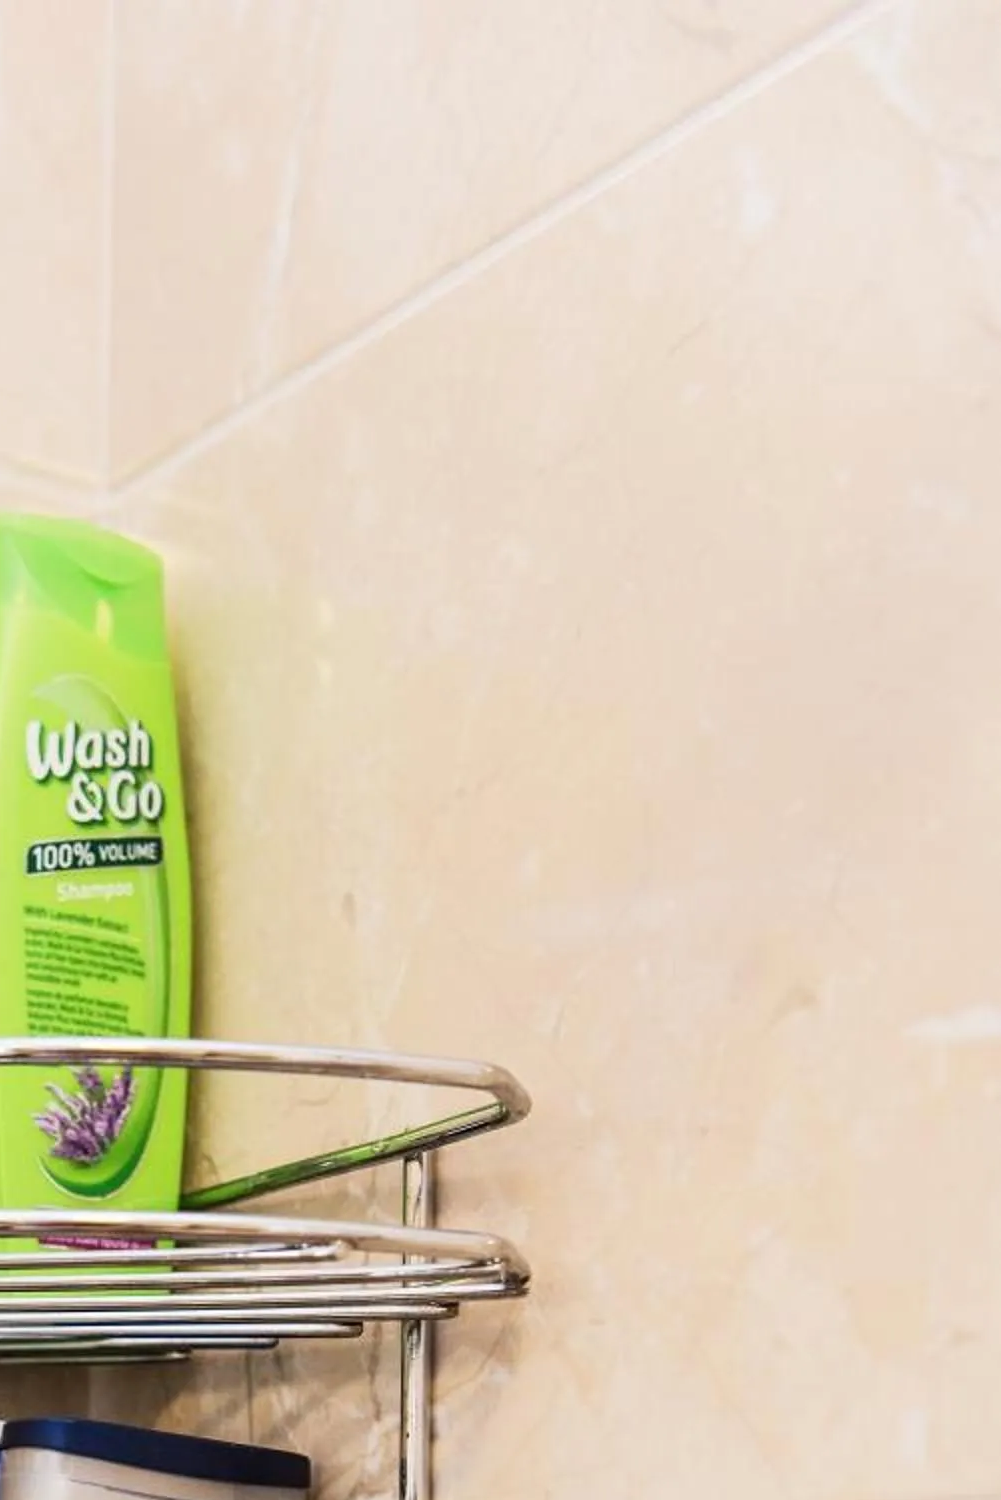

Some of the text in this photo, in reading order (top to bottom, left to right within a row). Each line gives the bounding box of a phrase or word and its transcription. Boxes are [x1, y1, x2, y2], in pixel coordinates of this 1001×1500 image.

[26, 719, 151, 780] Wash
[33, 841, 159, 870] 100% VOLUME
[56, 880, 135, 901] Shampoo
